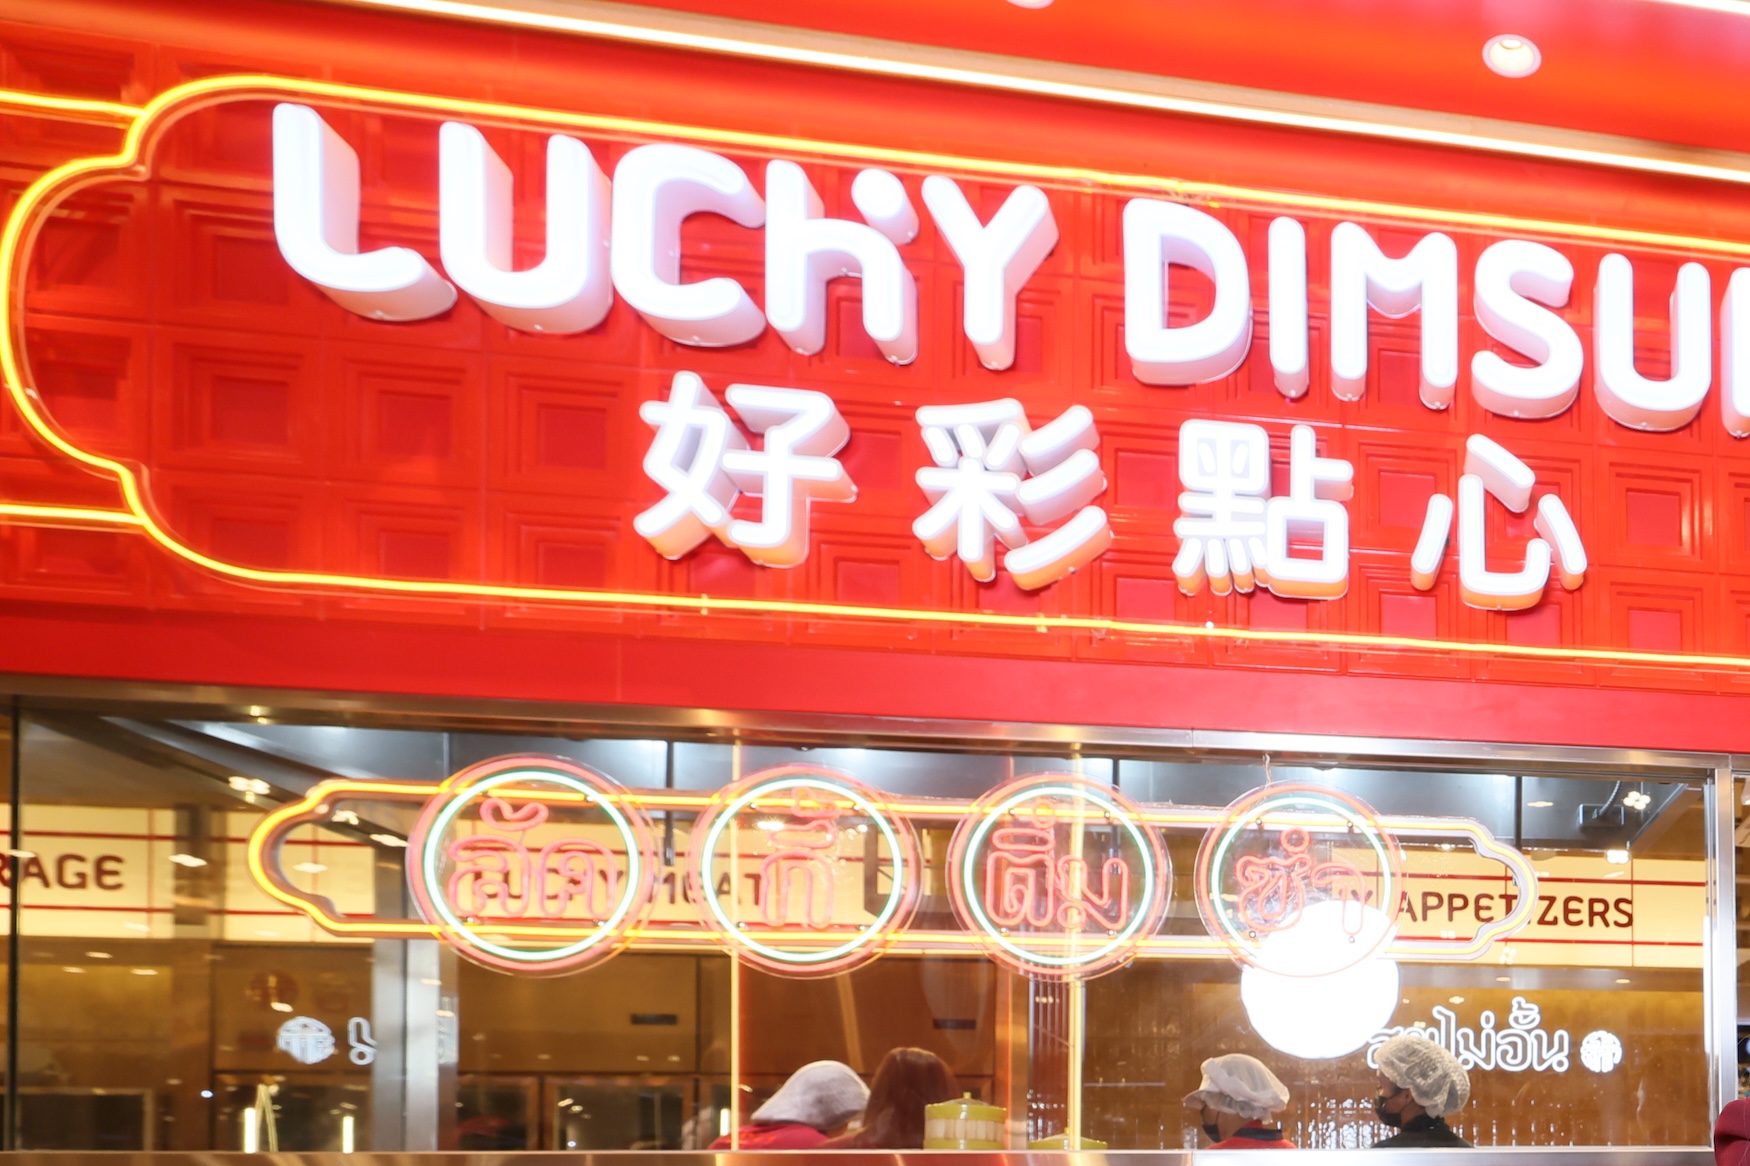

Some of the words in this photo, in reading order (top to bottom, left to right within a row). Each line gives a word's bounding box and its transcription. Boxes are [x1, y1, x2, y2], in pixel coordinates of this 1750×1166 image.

[633, 370, 1588, 611] 好彩點心
[1396, 890, 1634, 928] APPETZERS
